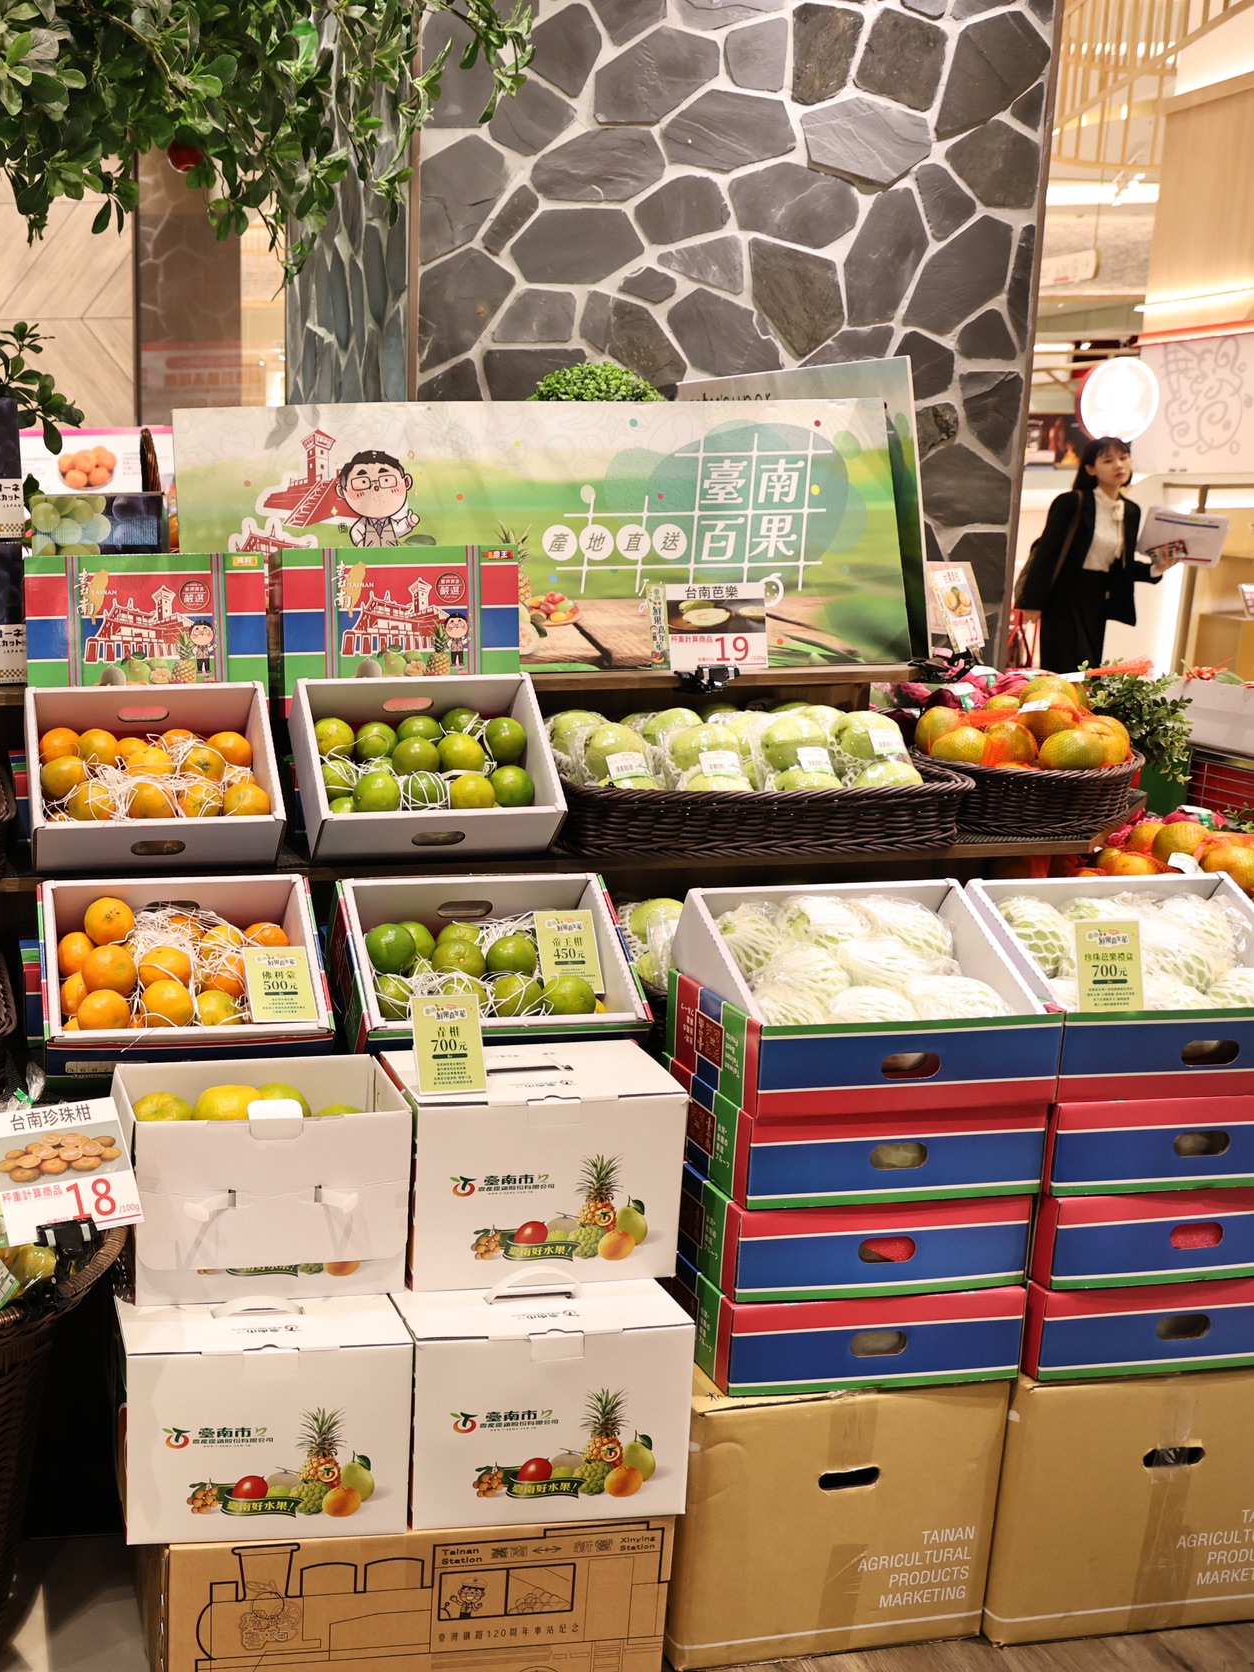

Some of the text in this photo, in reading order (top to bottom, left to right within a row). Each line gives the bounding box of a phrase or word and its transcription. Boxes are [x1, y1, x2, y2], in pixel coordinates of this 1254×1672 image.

[548, 531, 681, 553] 產地直送
[685, 586, 738, 599] 台南芭樂
[715, 636, 749, 662] 19
[552, 937, 583, 947] 帝王柑
[553, 948, 586, 959] 450元
[262, 971, 296, 980] 佛利蒙
[1092, 965, 1127, 977] 700元
[263, 980, 298, 990] 500元
[431, 1039, 467, 1052] 700元
[10, 1105, 92, 1131] 台南珍珠柑
[483, 1174, 534, 1185] 臺南市
[2, 1185, 63, 1203] 秤重計算商品
[66, 1178, 116, 1219] 18
[119, 1204, 140, 1214] /100g
[509, 1245, 572, 1256] 臺南好水果!
[486, 1410, 537, 1421] 臺南市
[198, 1427, 251, 1438] 臺南市
[511, 1482, 577, 1494] 臺南好水果!
[227, 1502, 295, 1513] 臺南好水果!
[620, 1535, 656, 1544] Xinying
[922, 1525, 975, 1544] TAINAN
[1176, 1529, 1254, 1549] AGRICULT
[441, 1547, 479, 1556] Tainan
[619, 1543, 656, 1552] Station
[441, 1556, 483, 1565] Station
[857, 1546, 972, 1572] AGRICULTURAL
[889, 1565, 969, 1588] PRODUCTS
[879, 1585, 966, 1608] MARKETING
